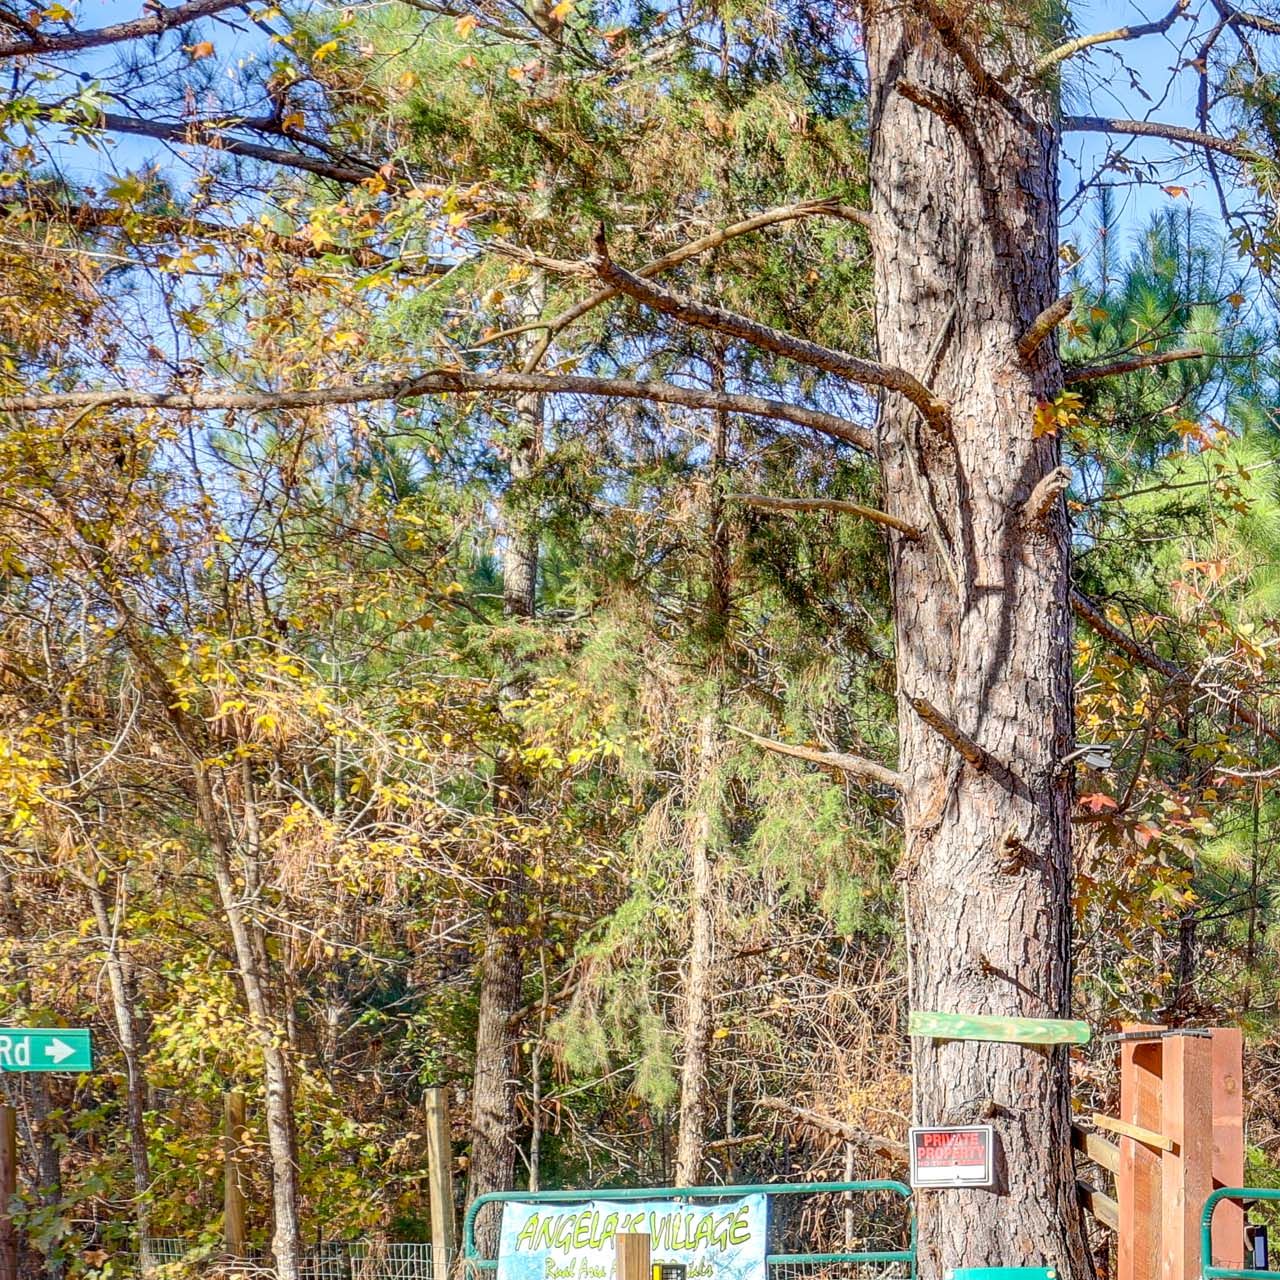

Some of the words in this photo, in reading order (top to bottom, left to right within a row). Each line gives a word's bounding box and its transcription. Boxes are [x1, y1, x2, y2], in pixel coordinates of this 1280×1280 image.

[0, 1035, 30, 1066] Rd
[923, 1132, 979, 1147] PRIVATE
[917, 1145, 985, 1160] PROPERTY
[516, 1211, 645, 1254] ANGELA'S
[650, 1206, 751, 1252] VILLAGE
